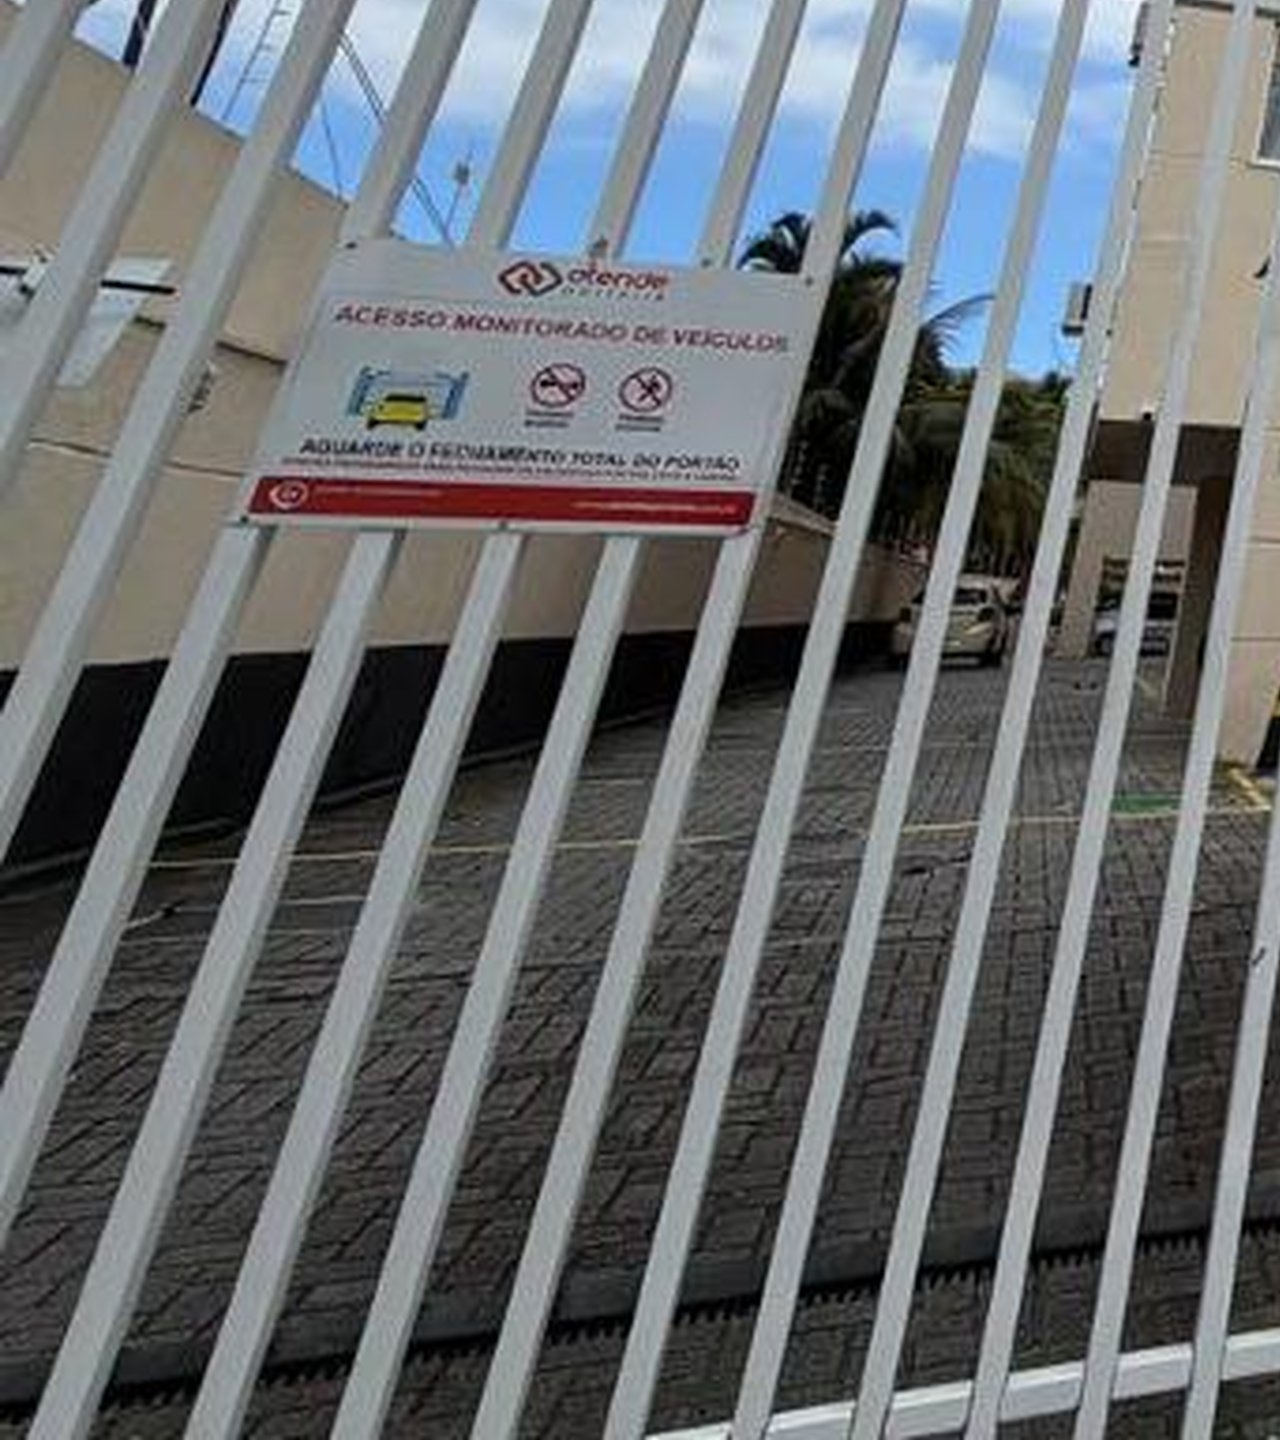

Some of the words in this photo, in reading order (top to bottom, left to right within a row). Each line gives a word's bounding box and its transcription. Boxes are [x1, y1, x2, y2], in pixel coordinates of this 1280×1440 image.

[567, 262, 669, 290] atende
[334, 305, 447, 329] ACESSO
[450, 313, 628, 340] MONITORADO
[632, 325, 668, 345] DE
[673, 327, 788, 352] VEÍCULOS
[572, 450, 627, 466] TOTAL
[632, 453, 662, 470] DO
[664, 451, 741, 473] PORTÃO
